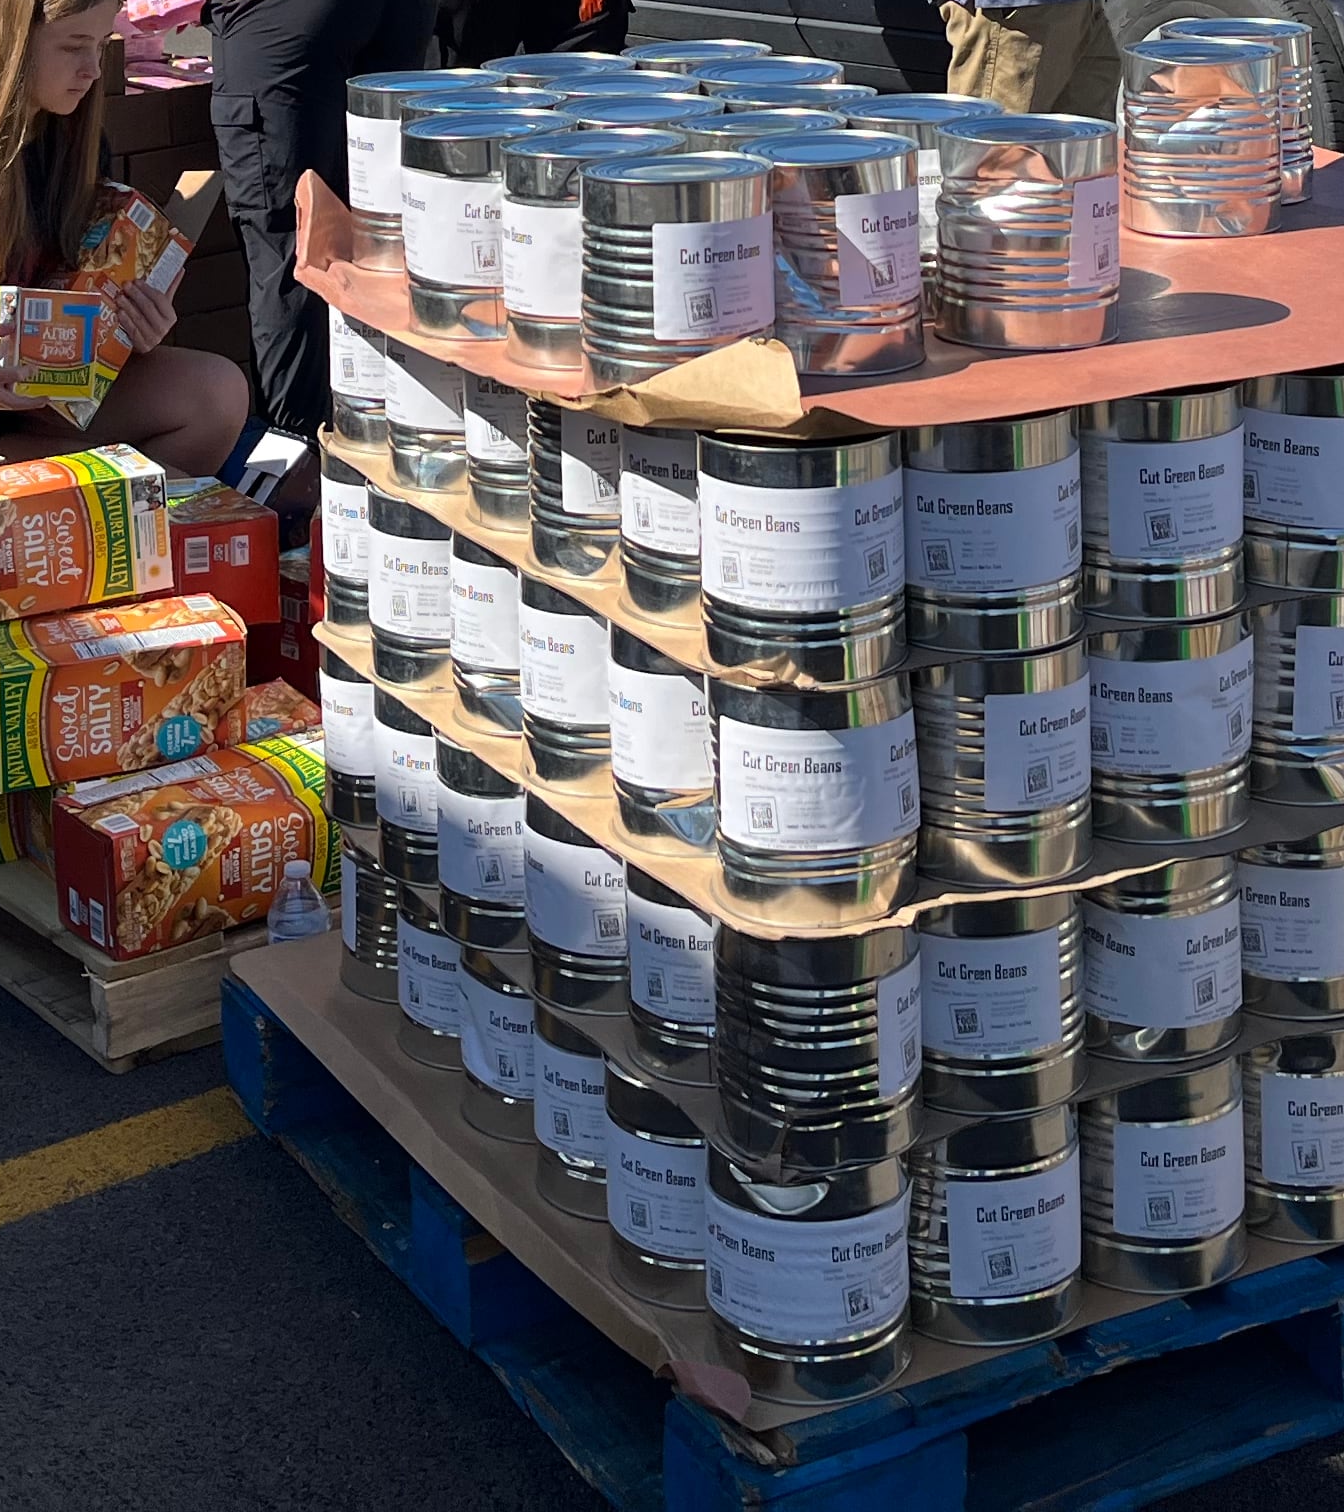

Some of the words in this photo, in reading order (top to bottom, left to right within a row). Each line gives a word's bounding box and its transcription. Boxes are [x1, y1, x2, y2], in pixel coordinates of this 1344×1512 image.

[464, 203, 481, 219] Cut
[680, 246, 702, 265] Cut
[704, 245, 735, 263] Green
[738, 244, 760, 261] Beans
[587, 430, 606, 444] Cut
[1249, 433, 1281, 452] Green
[1284, 438, 1320, 457] Beans
[1140, 468, 1160, 485] Cut
[1164, 468, 1195, 483] Green
[1198, 464, 1225, 480] Beans
[100, 482, 125, 537] NATURE
[917, 495, 935, 514] Cut
[938, 498, 973, 517] Green
[976, 499, 1013, 515] Beans
[715, 506, 728, 523] Cut
[730, 510, 762, 531] Green
[765, 516, 800, 533] Beans
[5, 538, 15, 573] Peanut
[23, 516, 49, 586] SALTY
[50, 507, 83, 584] Sweet
[107, 539, 129, 589] VALLEY
[468, 586, 494, 603] Beans
[4, 681, 28, 731] VALLEY
[1100, 683, 1135, 704] Green
[1138, 687, 1173, 703] Beans
[53, 686, 83, 762] Sweet
[89, 684, 112, 755] SALTY
[122, 697, 131, 731] Peanut
[1019, 719, 1037, 737] Cut
[1040, 715, 1069, 734] Green
[1070, 707, 1087, 730] Beans
[6, 732, 34, 787] NATURE
[392, 750, 405, 766] Cut
[407, 754, 430, 770] Green
[743, 751, 761, 770] Cut
[765, 755, 800, 775] Green
[804, 757, 842, 774] Beans
[468, 819, 482, 835] Cut
[484, 822, 512, 836] Green
[250, 822, 272, 893] SALTY
[1245, 890, 1277, 907] Green
[1279, 892, 1310, 908] Beans
[938, 962, 956, 980] Cut
[959, 964, 991, 981] Green
[995, 963, 1028, 980] Beans
[489, 1011, 501, 1027] Cut
[503, 1016, 528, 1033] Green
[1288, 1100, 1305, 1118] Cut
[1309, 1101, 1344, 1118] Green
[1141, 1151, 1159, 1168] Cut
[1163, 1150, 1198, 1167] Green
[1201, 1144, 1226, 1163] Beans
[621, 1153, 634, 1172] Cut
[635, 1161, 663, 1182] Green
[666, 1169, 696, 1188] Beans
[976, 1206, 997, 1224] Cut
[1001, 1202, 1035, 1221] Green
[1037, 1192, 1065, 1217] Beans
[716, 1227, 739, 1251] Green
[741, 1237, 775, 1263] Beans
